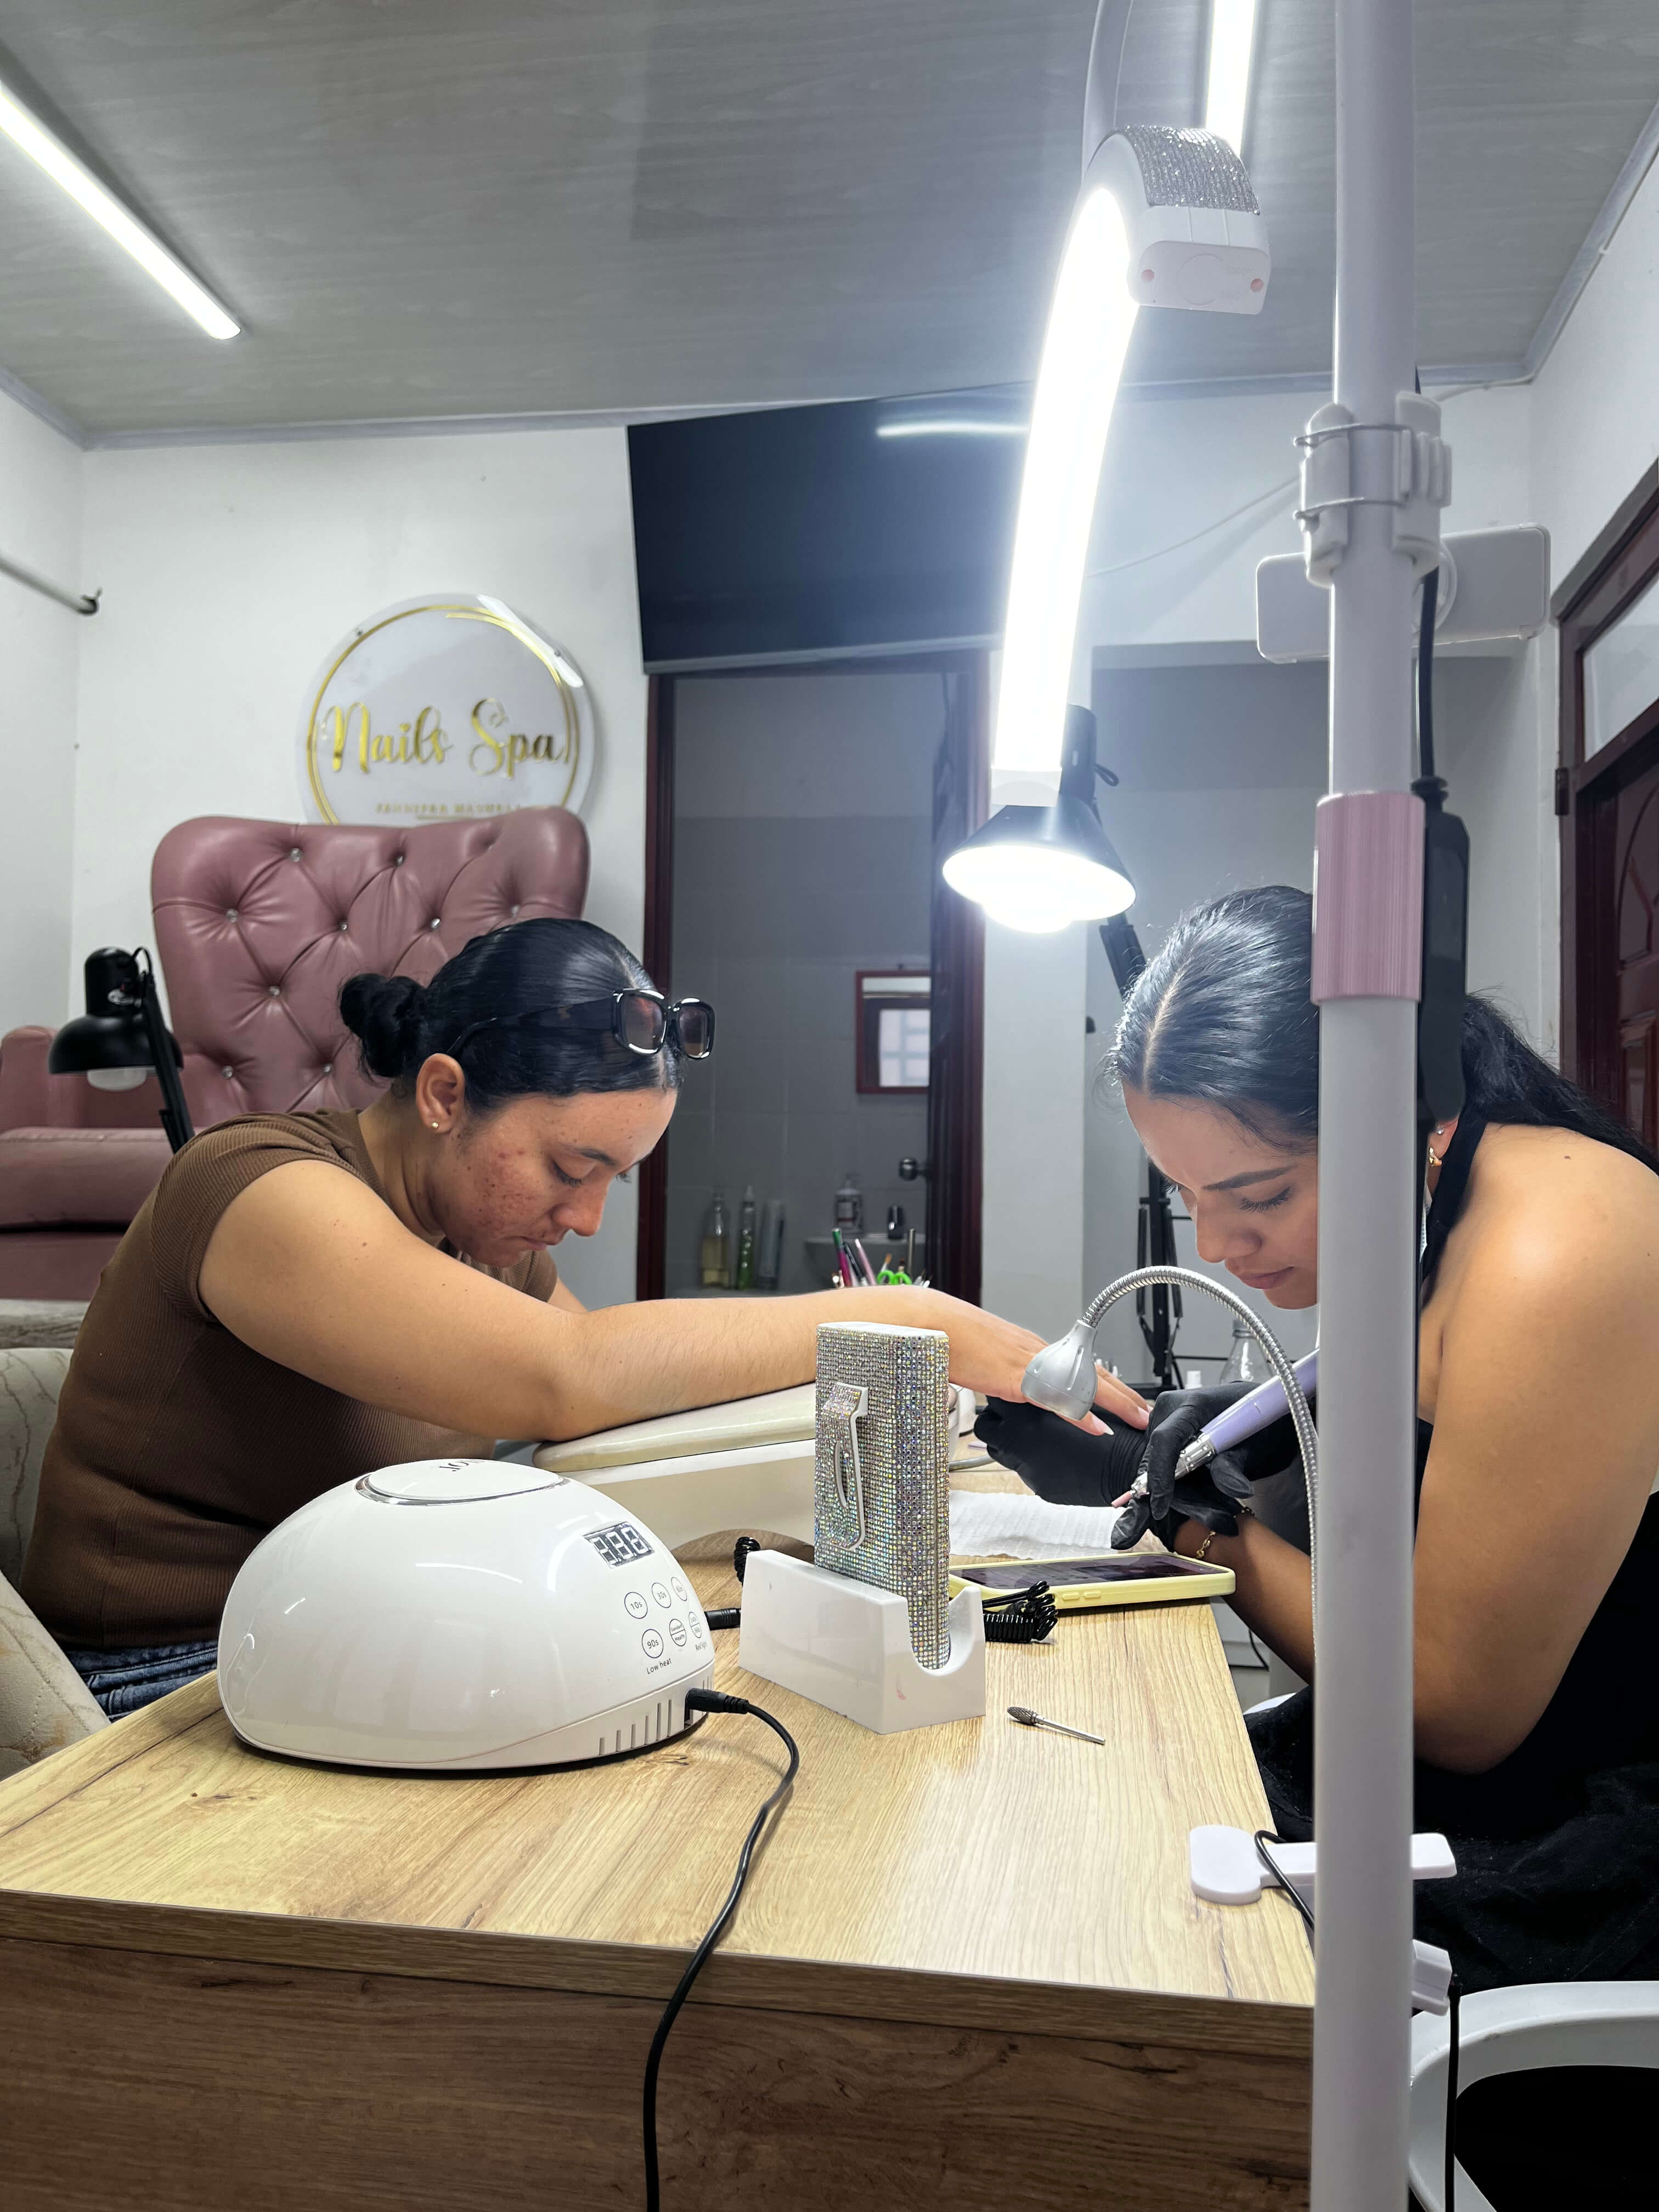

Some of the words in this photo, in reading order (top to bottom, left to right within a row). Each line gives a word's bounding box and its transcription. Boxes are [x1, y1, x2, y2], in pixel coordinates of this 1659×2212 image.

[321, 702, 454, 774] Nails
[469, 697, 565, 779] Spa
[656, 1592, 667, 1600] 30s
[630, 1601, 643, 1610] 10s
[647, 1639, 659, 1649] 90s
[646, 1664, 659, 1674] Low
[659, 1657, 672, 1668] heat
